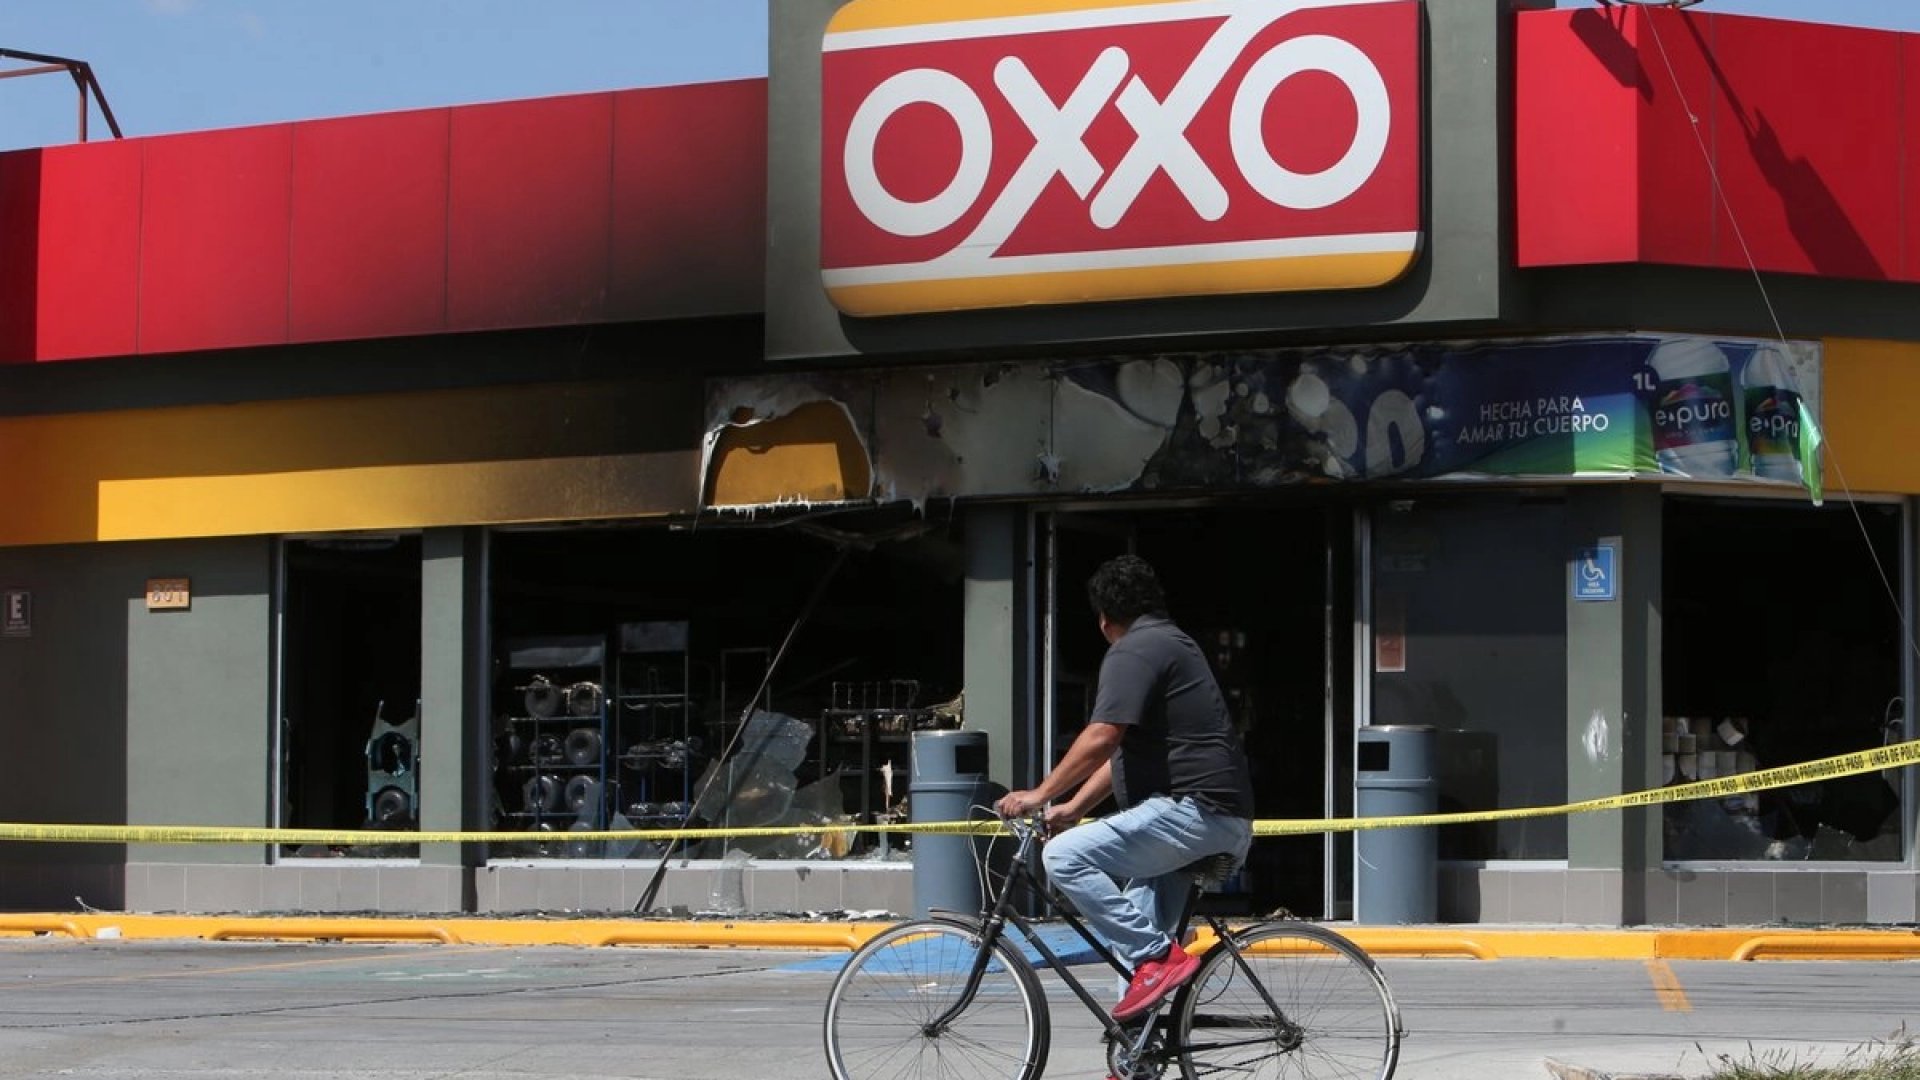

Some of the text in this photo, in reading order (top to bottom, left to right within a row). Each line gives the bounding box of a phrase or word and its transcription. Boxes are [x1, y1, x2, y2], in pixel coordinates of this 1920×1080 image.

[844, 26, 1391, 246] OXXO
[1632, 371, 1656, 391] 1L
[1479, 396, 1584, 421] HECHA PARA
[1456, 413, 1609, 444] AMAR TU CUERPO
[11, 594, 22, 618] E
[1762, 772, 1773, 787] DE
[1773, 767, 1799, 785] POLICIA
[1799, 760, 1836, 780] PROHIBIDO
[1836, 759, 1846, 773] EL
[1846, 755, 1864, 771] PASO
[1869, 749, 1889, 766] LINEA
[1889, 747, 1900, 763] DE
